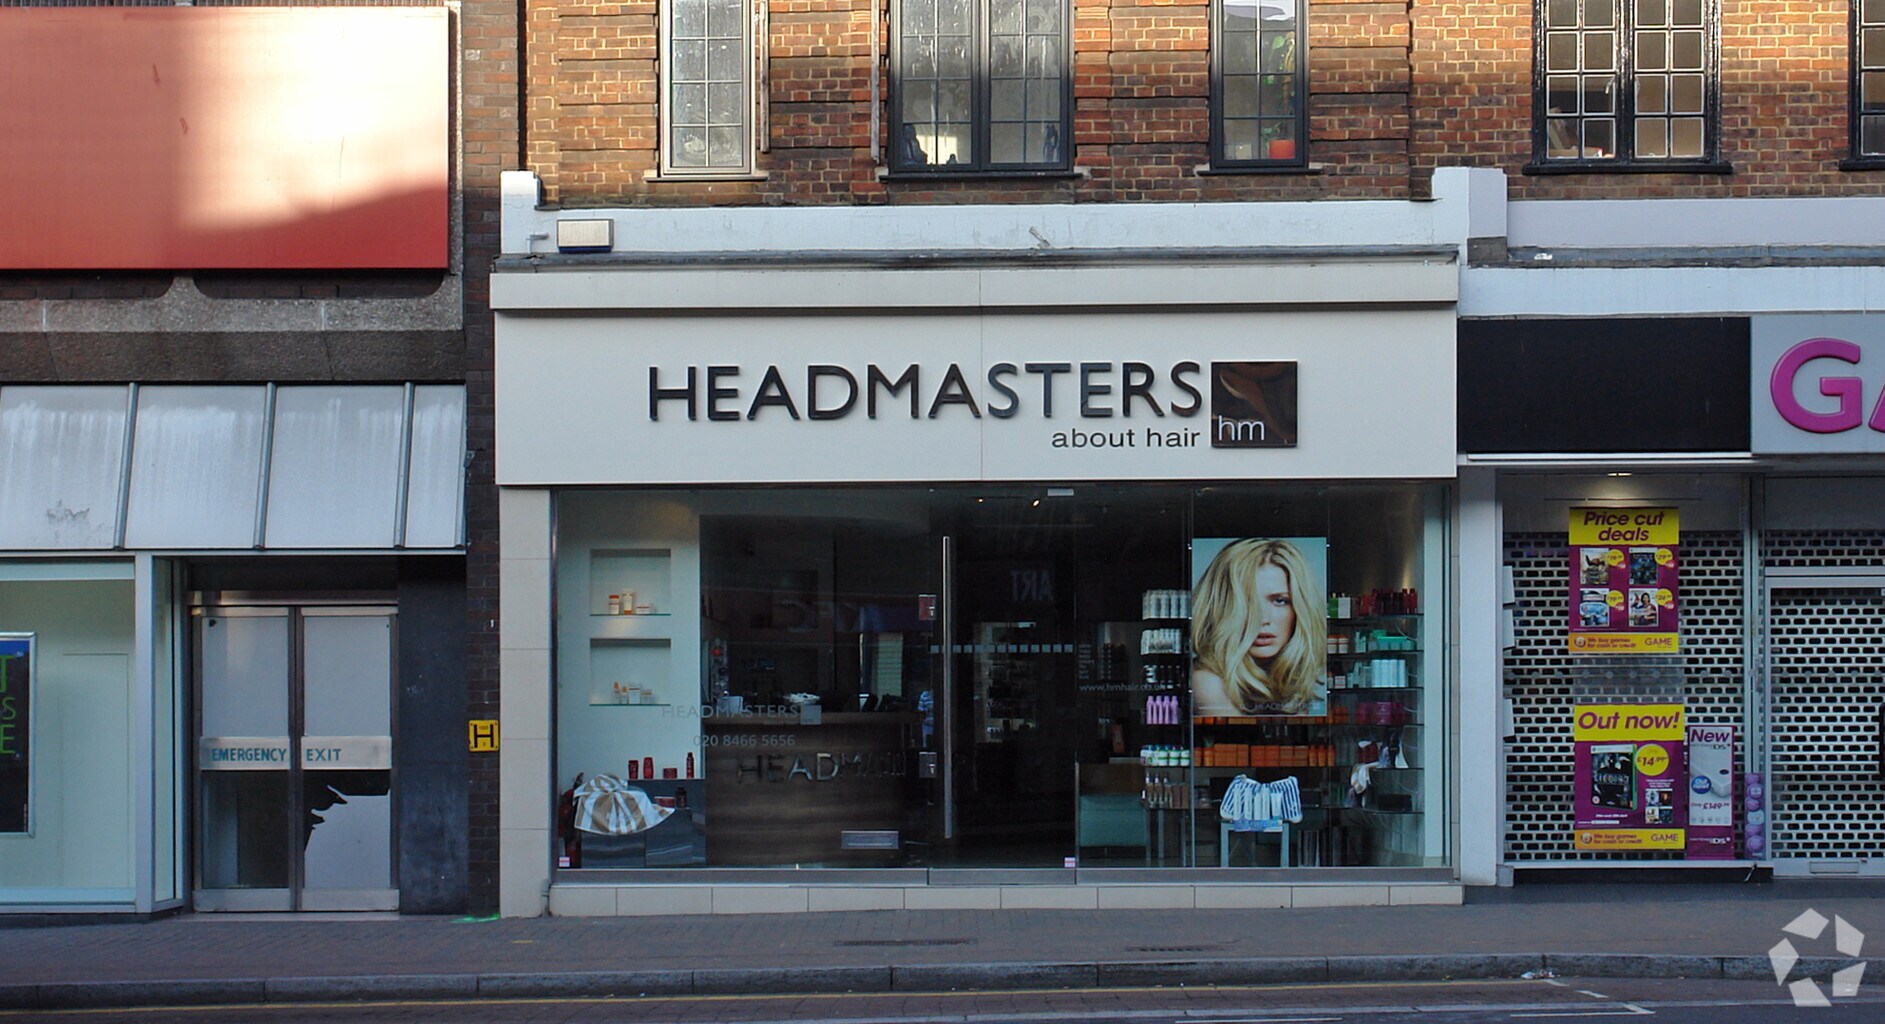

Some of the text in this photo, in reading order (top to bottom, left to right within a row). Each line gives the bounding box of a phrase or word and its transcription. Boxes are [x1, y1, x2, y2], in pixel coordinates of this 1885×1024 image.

[649, 361, 1203, 421] HEADMASTERS
[1769, 337, 1885, 434] G
[1218, 415, 1266, 442] hm
[1051, 428, 1201, 448] about hair
[1583, 511, 1665, 526] Price cut
[1598, 527, 1650, 541] deals
[1644, 637, 1673, 646] GAME
[661, 704, 799, 718] HEADMASTERS
[1578, 711, 1680, 730] Out now!
[473, 723, 494, 748] H
[693, 735, 796, 747] 020 8466 5656
[1690, 728, 1730, 743] New
[211, 748, 342, 762] EMERGENCY EXIT
[1650, 833, 1679, 842] GAME
